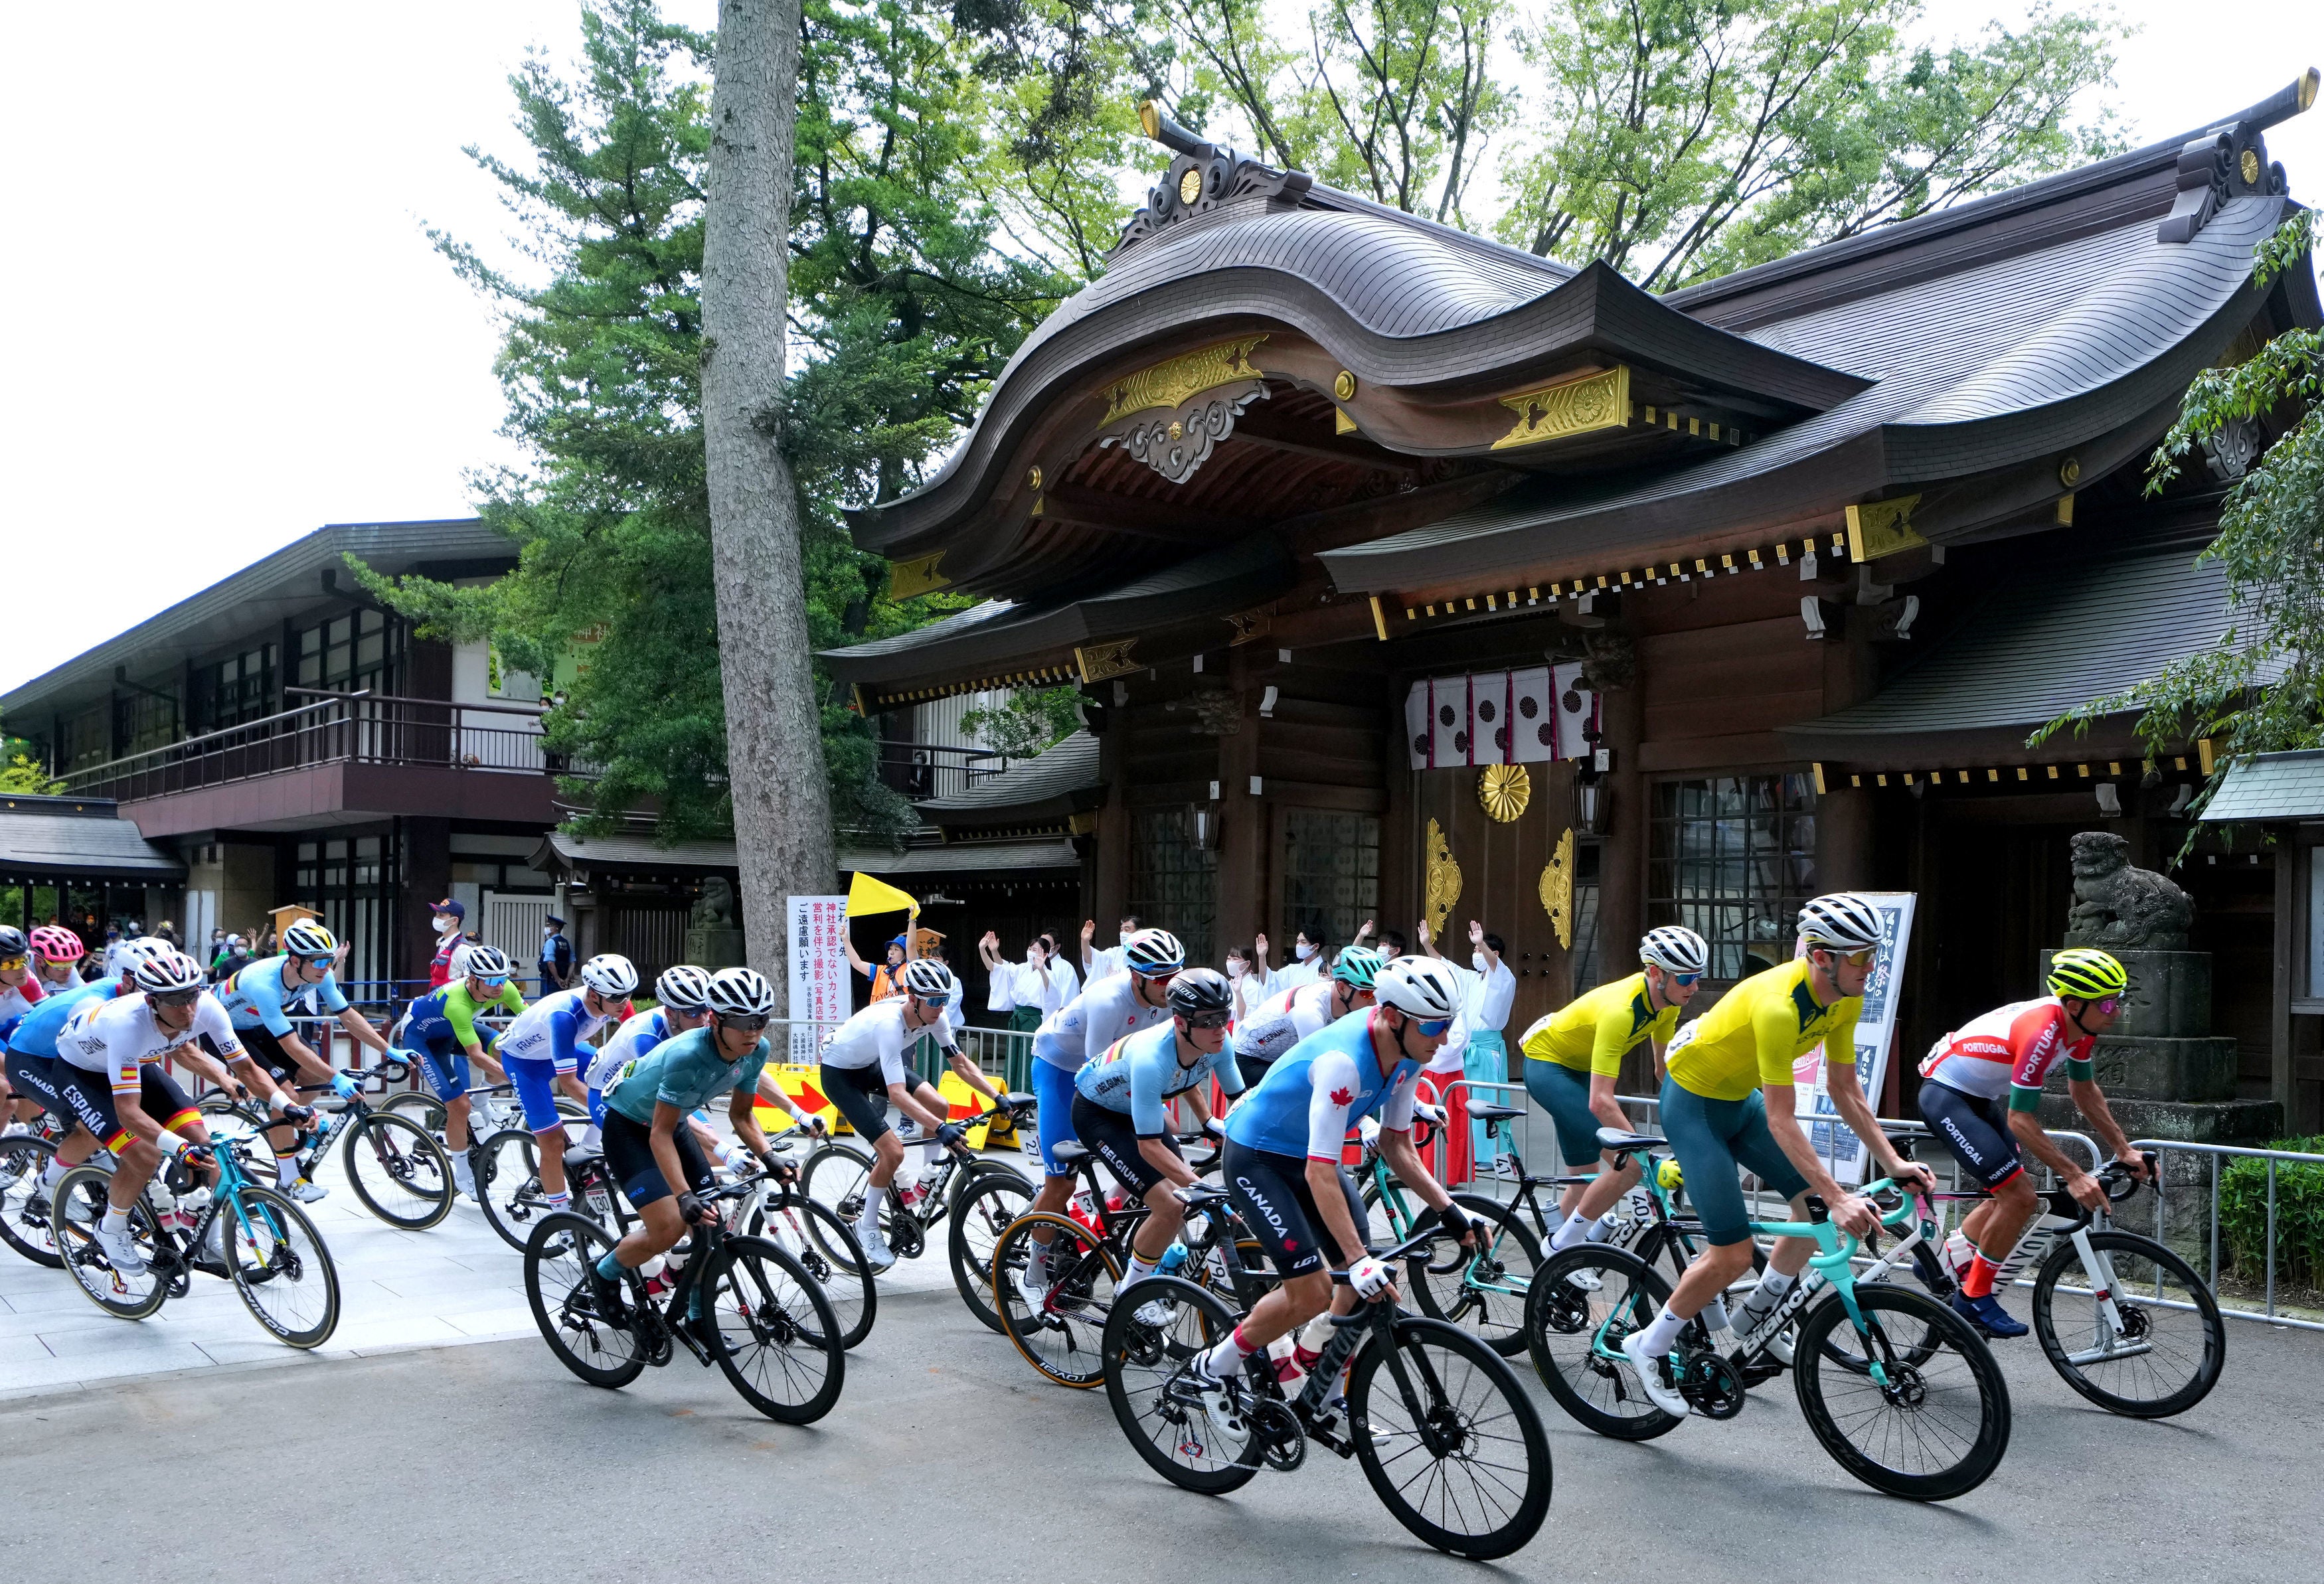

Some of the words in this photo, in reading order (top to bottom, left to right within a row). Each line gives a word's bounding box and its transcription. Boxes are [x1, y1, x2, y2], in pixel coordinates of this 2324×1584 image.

[798, 903, 809, 981] ご遠慮願います
[583, 975, 600, 989] HJC
[78, 1036, 108, 1055] ESPAÑA
[516, 1033, 546, 1052] FRANCE
[1263, 1028, 1287, 1043] GERMANY
[1963, 1042, 2011, 1056] PORTUGAL
[423, 1056, 442, 1092] SLOVENIA
[509, 1072, 529, 1115] FRANCE
[659, 1091, 677, 1101] HKG
[62, 1084, 106, 1136] ESPAÑA
[1026, 1140, 1040, 1157] 27
[1940, 1117, 1983, 1166] PORTUGAL
[1100, 1144, 1140, 1186] BELGIUM
[1495, 1158, 1512, 1175] 41
[592, 1196, 610, 1212] 130
[1236, 1176, 1289, 1239] CANADA
[1631, 1195, 1650, 1217] 40
[1208, 1254, 1226, 1279] 79
[1993, 1226, 2054, 1298] CANYON
[1742, 1268, 1821, 1359] Bianchi
